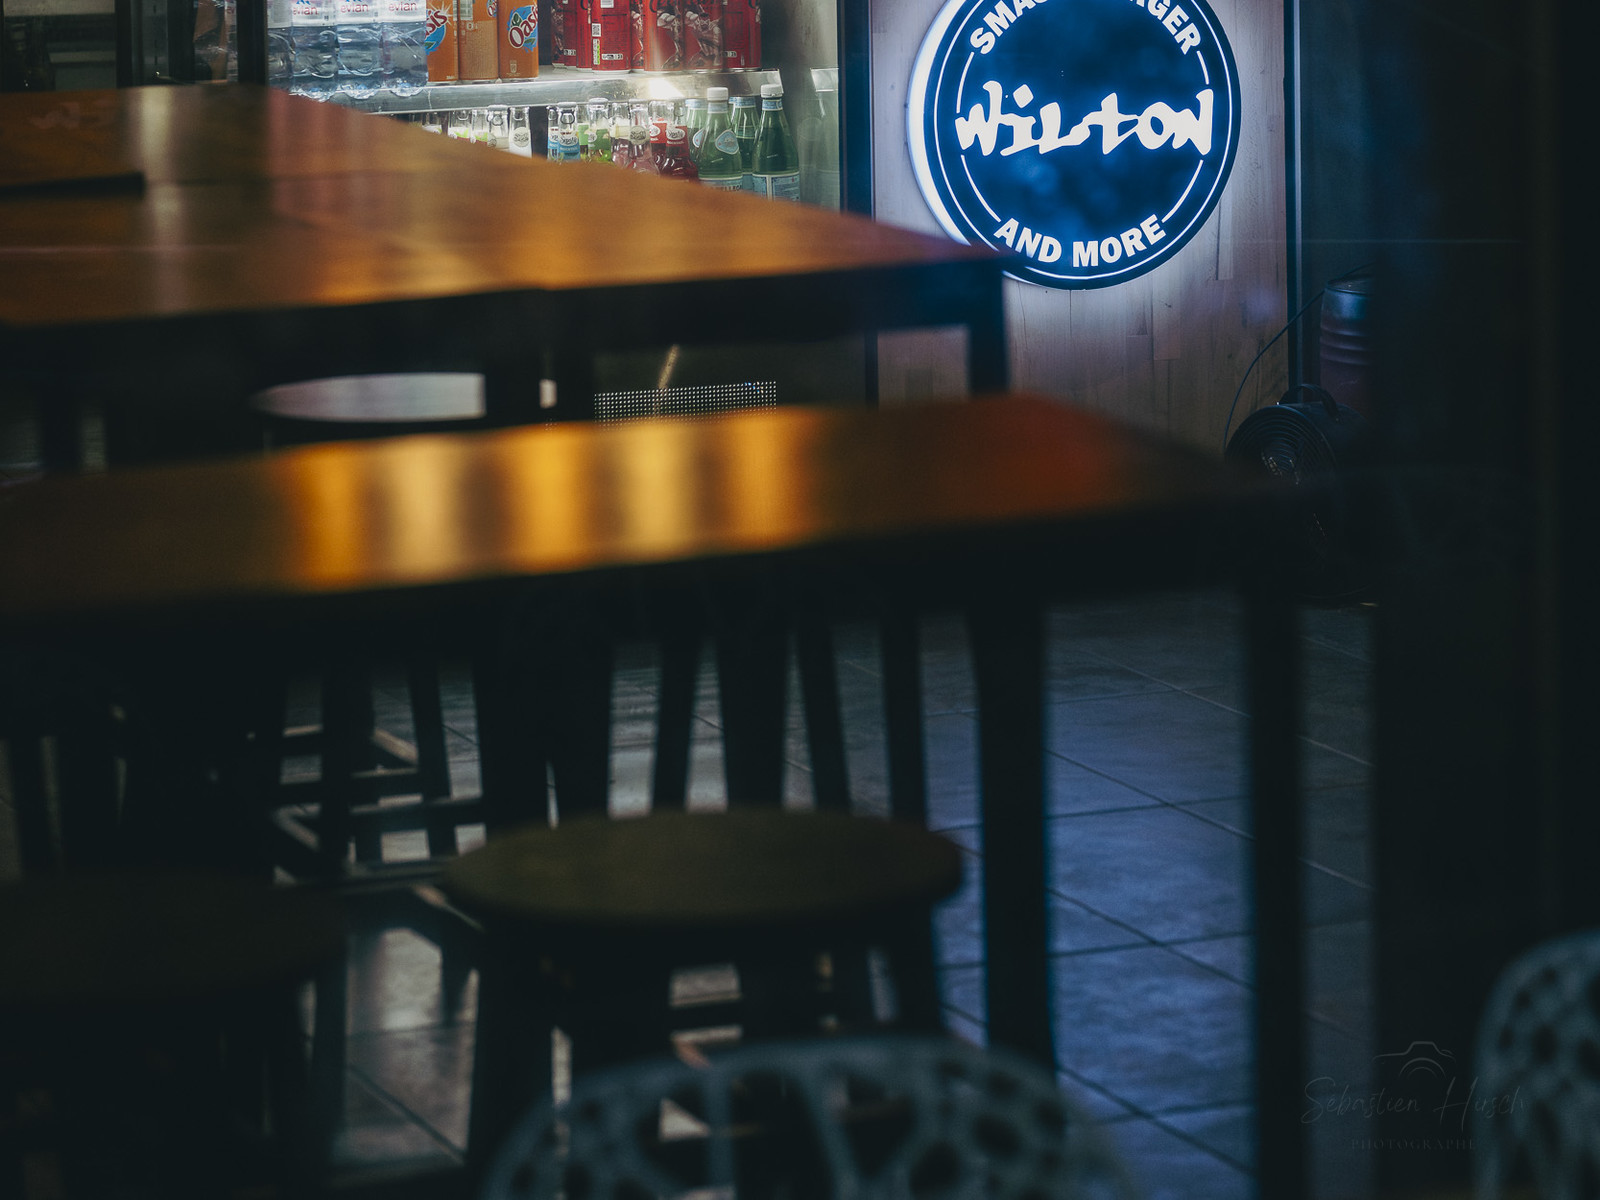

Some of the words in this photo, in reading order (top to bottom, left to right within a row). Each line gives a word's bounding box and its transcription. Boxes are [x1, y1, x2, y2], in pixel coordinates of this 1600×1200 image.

[340, 3, 369, 14] evian
[388, 1, 418, 13] evian
[994, 217, 1062, 263] AND
[1072, 214, 1167, 268] MORE
